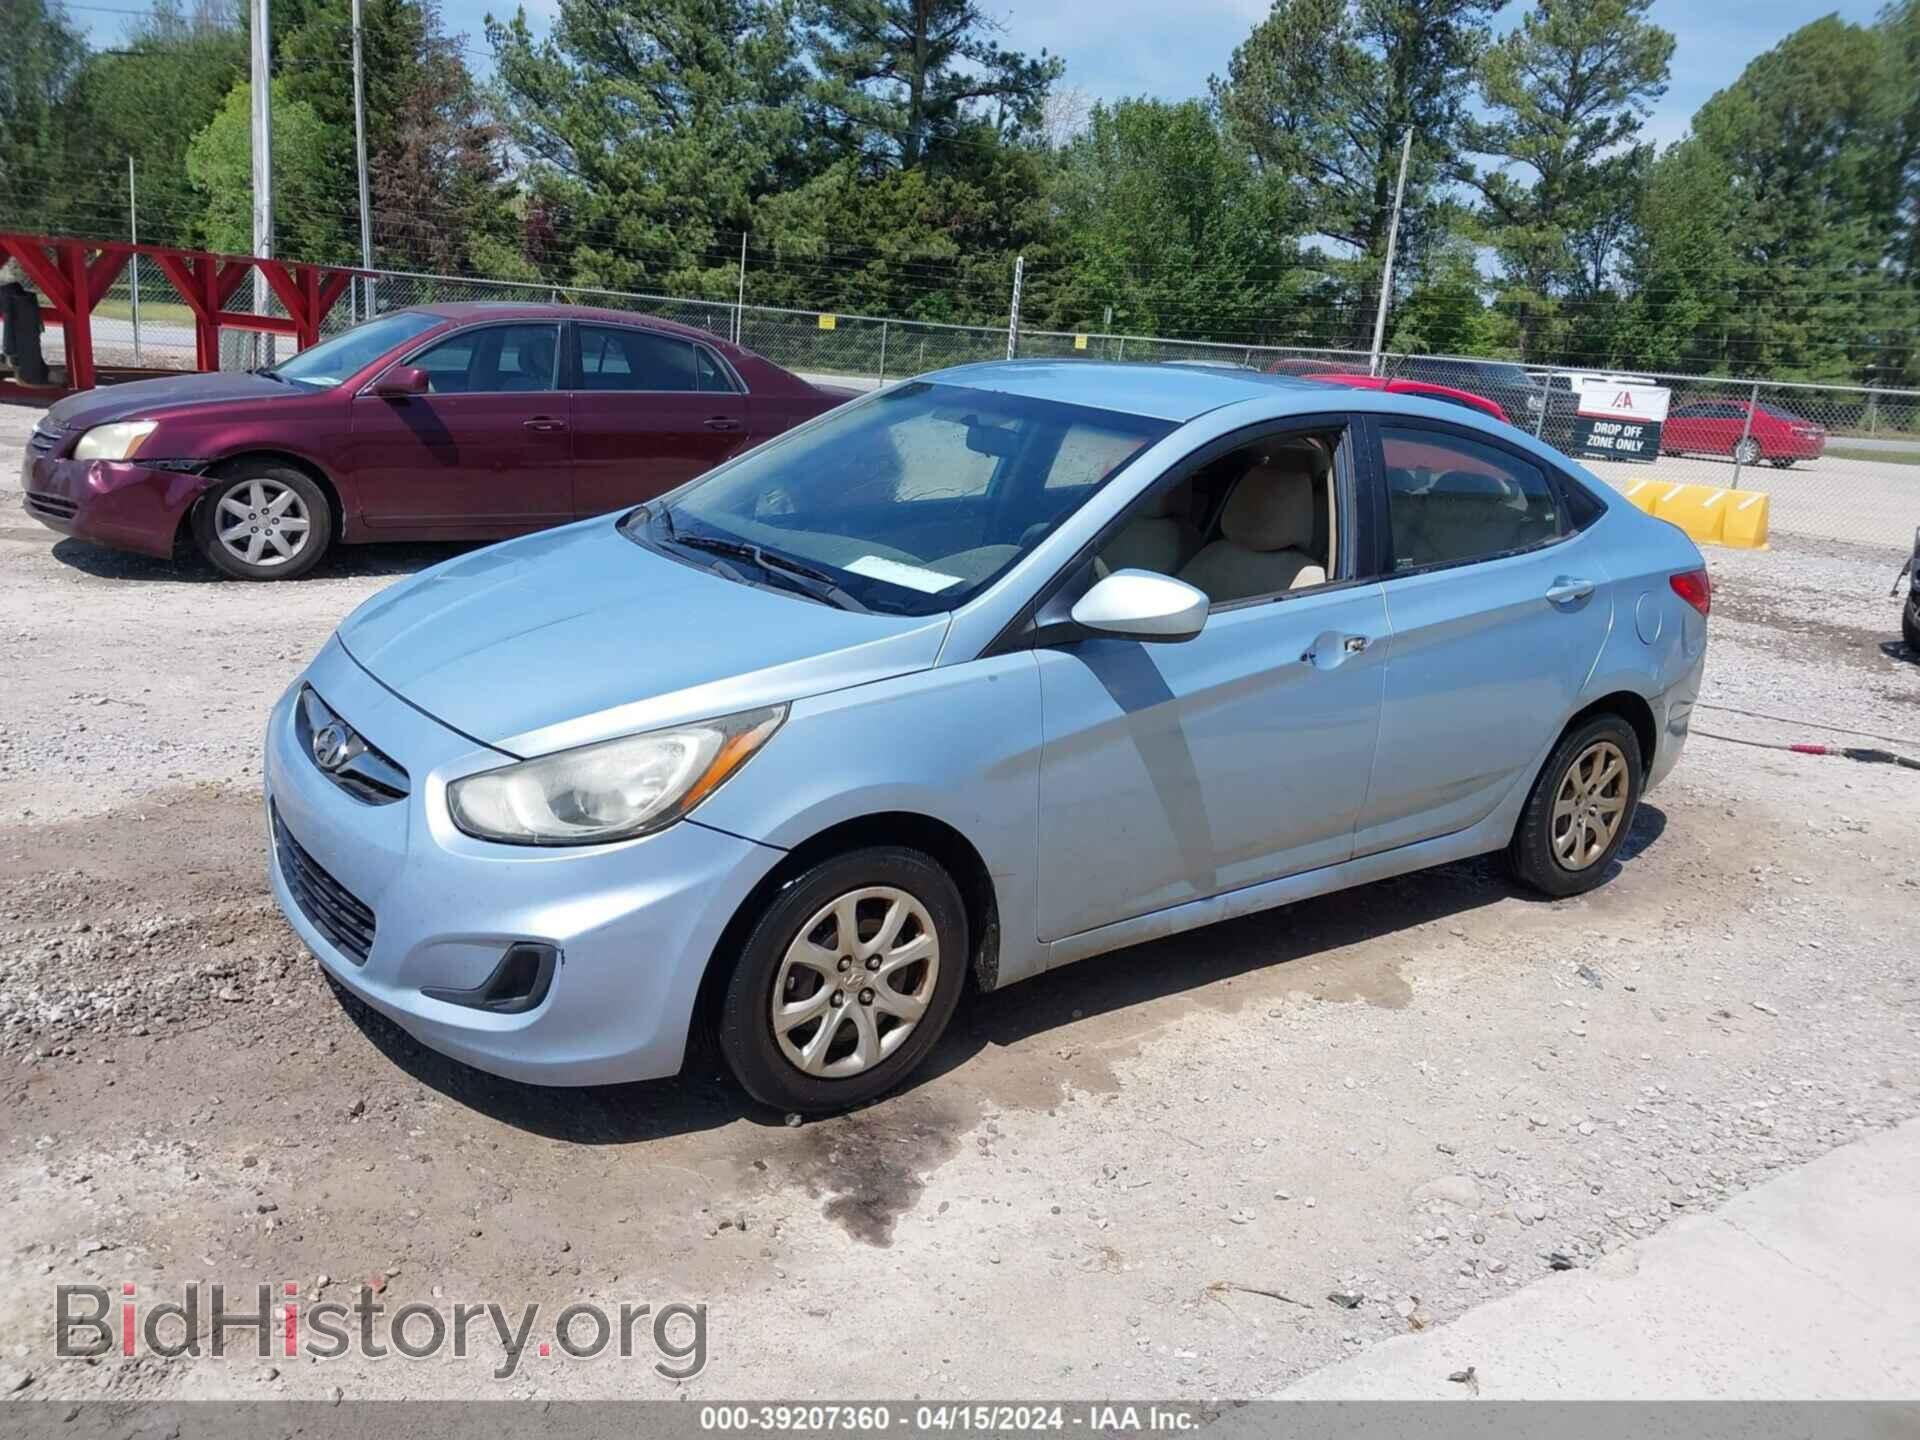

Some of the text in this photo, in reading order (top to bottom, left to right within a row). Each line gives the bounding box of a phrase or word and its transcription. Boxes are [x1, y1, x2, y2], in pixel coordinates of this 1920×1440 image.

[1593, 421, 1643, 438] DROP OFF
[1586, 434, 1644, 452] ZONE ONLY
